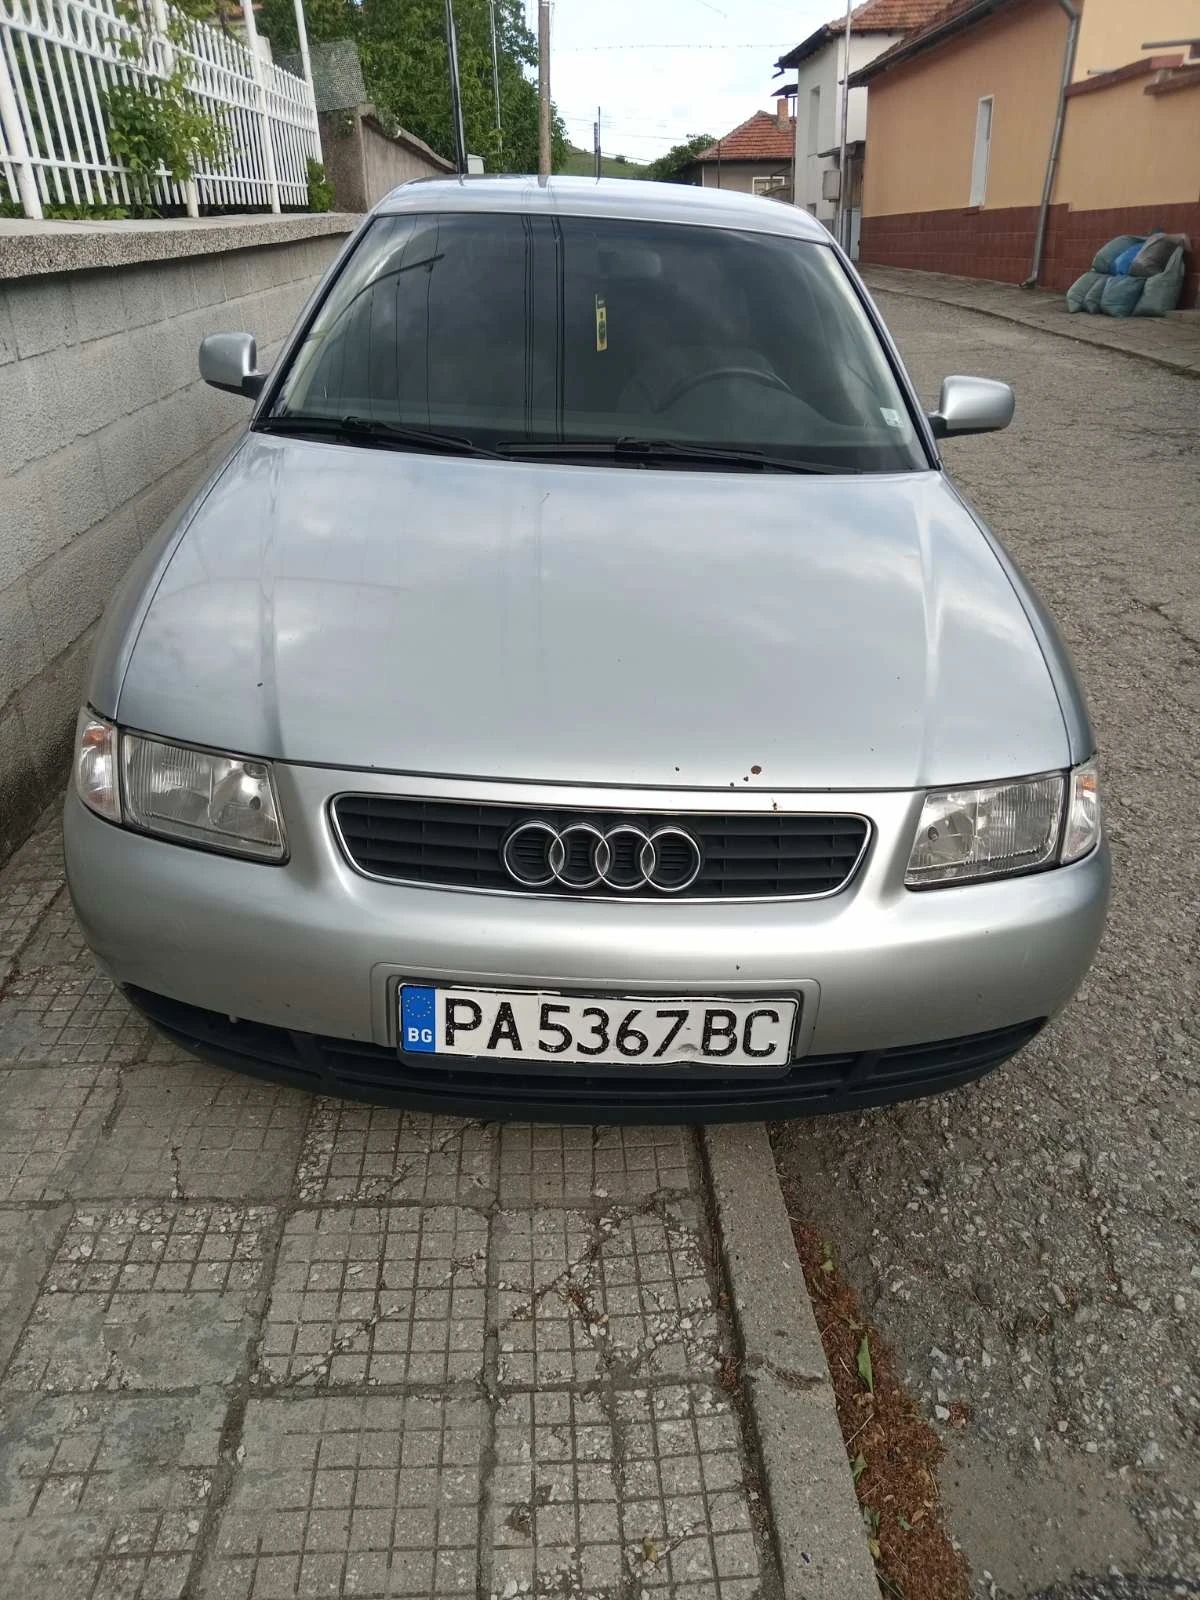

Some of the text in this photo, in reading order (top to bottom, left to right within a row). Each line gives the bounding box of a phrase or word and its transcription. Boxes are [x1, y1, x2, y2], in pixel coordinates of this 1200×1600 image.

[407, 1027, 433, 1043] BG
[444, 997, 779, 1057] PA 5367 BC
